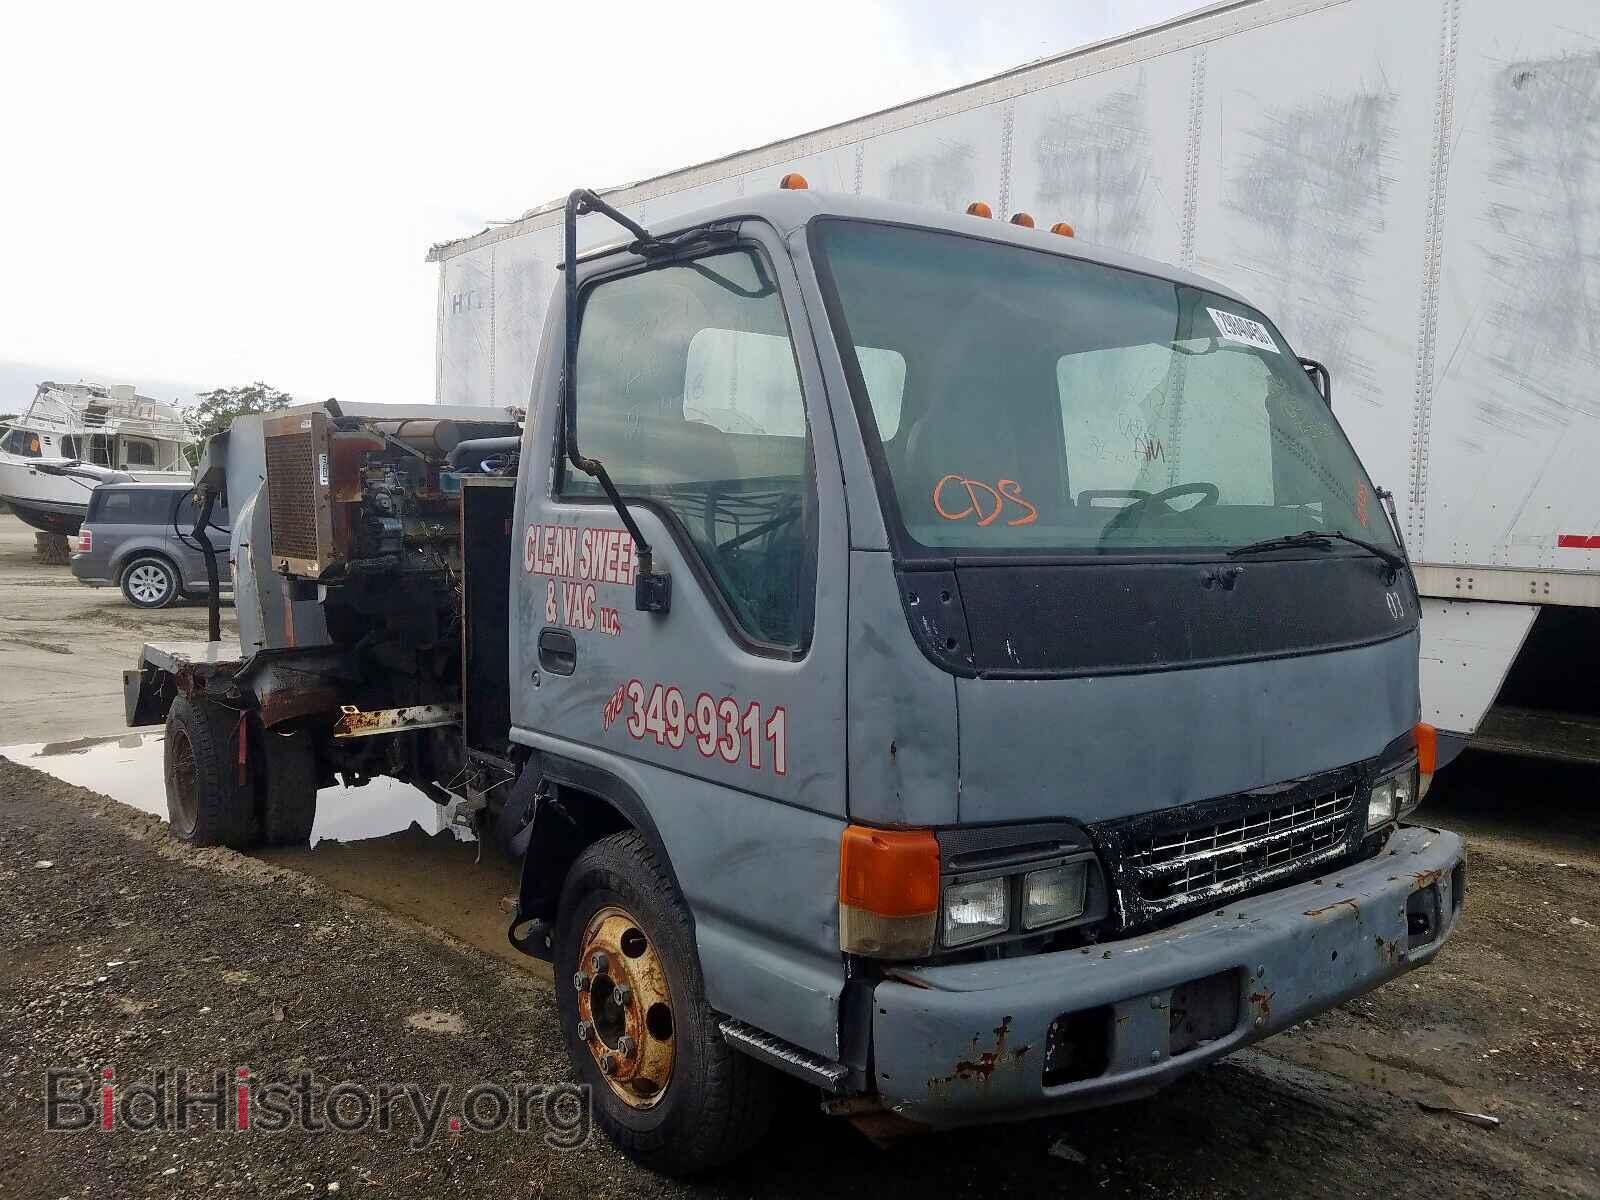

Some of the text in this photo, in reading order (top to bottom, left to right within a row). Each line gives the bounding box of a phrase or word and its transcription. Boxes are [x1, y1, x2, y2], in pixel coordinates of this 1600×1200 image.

[932, 474, 1037, 527] CDS
[524, 523, 578, 578] CLEAN
[544, 578, 557, 625] &
[561, 580, 597, 632] VAC
